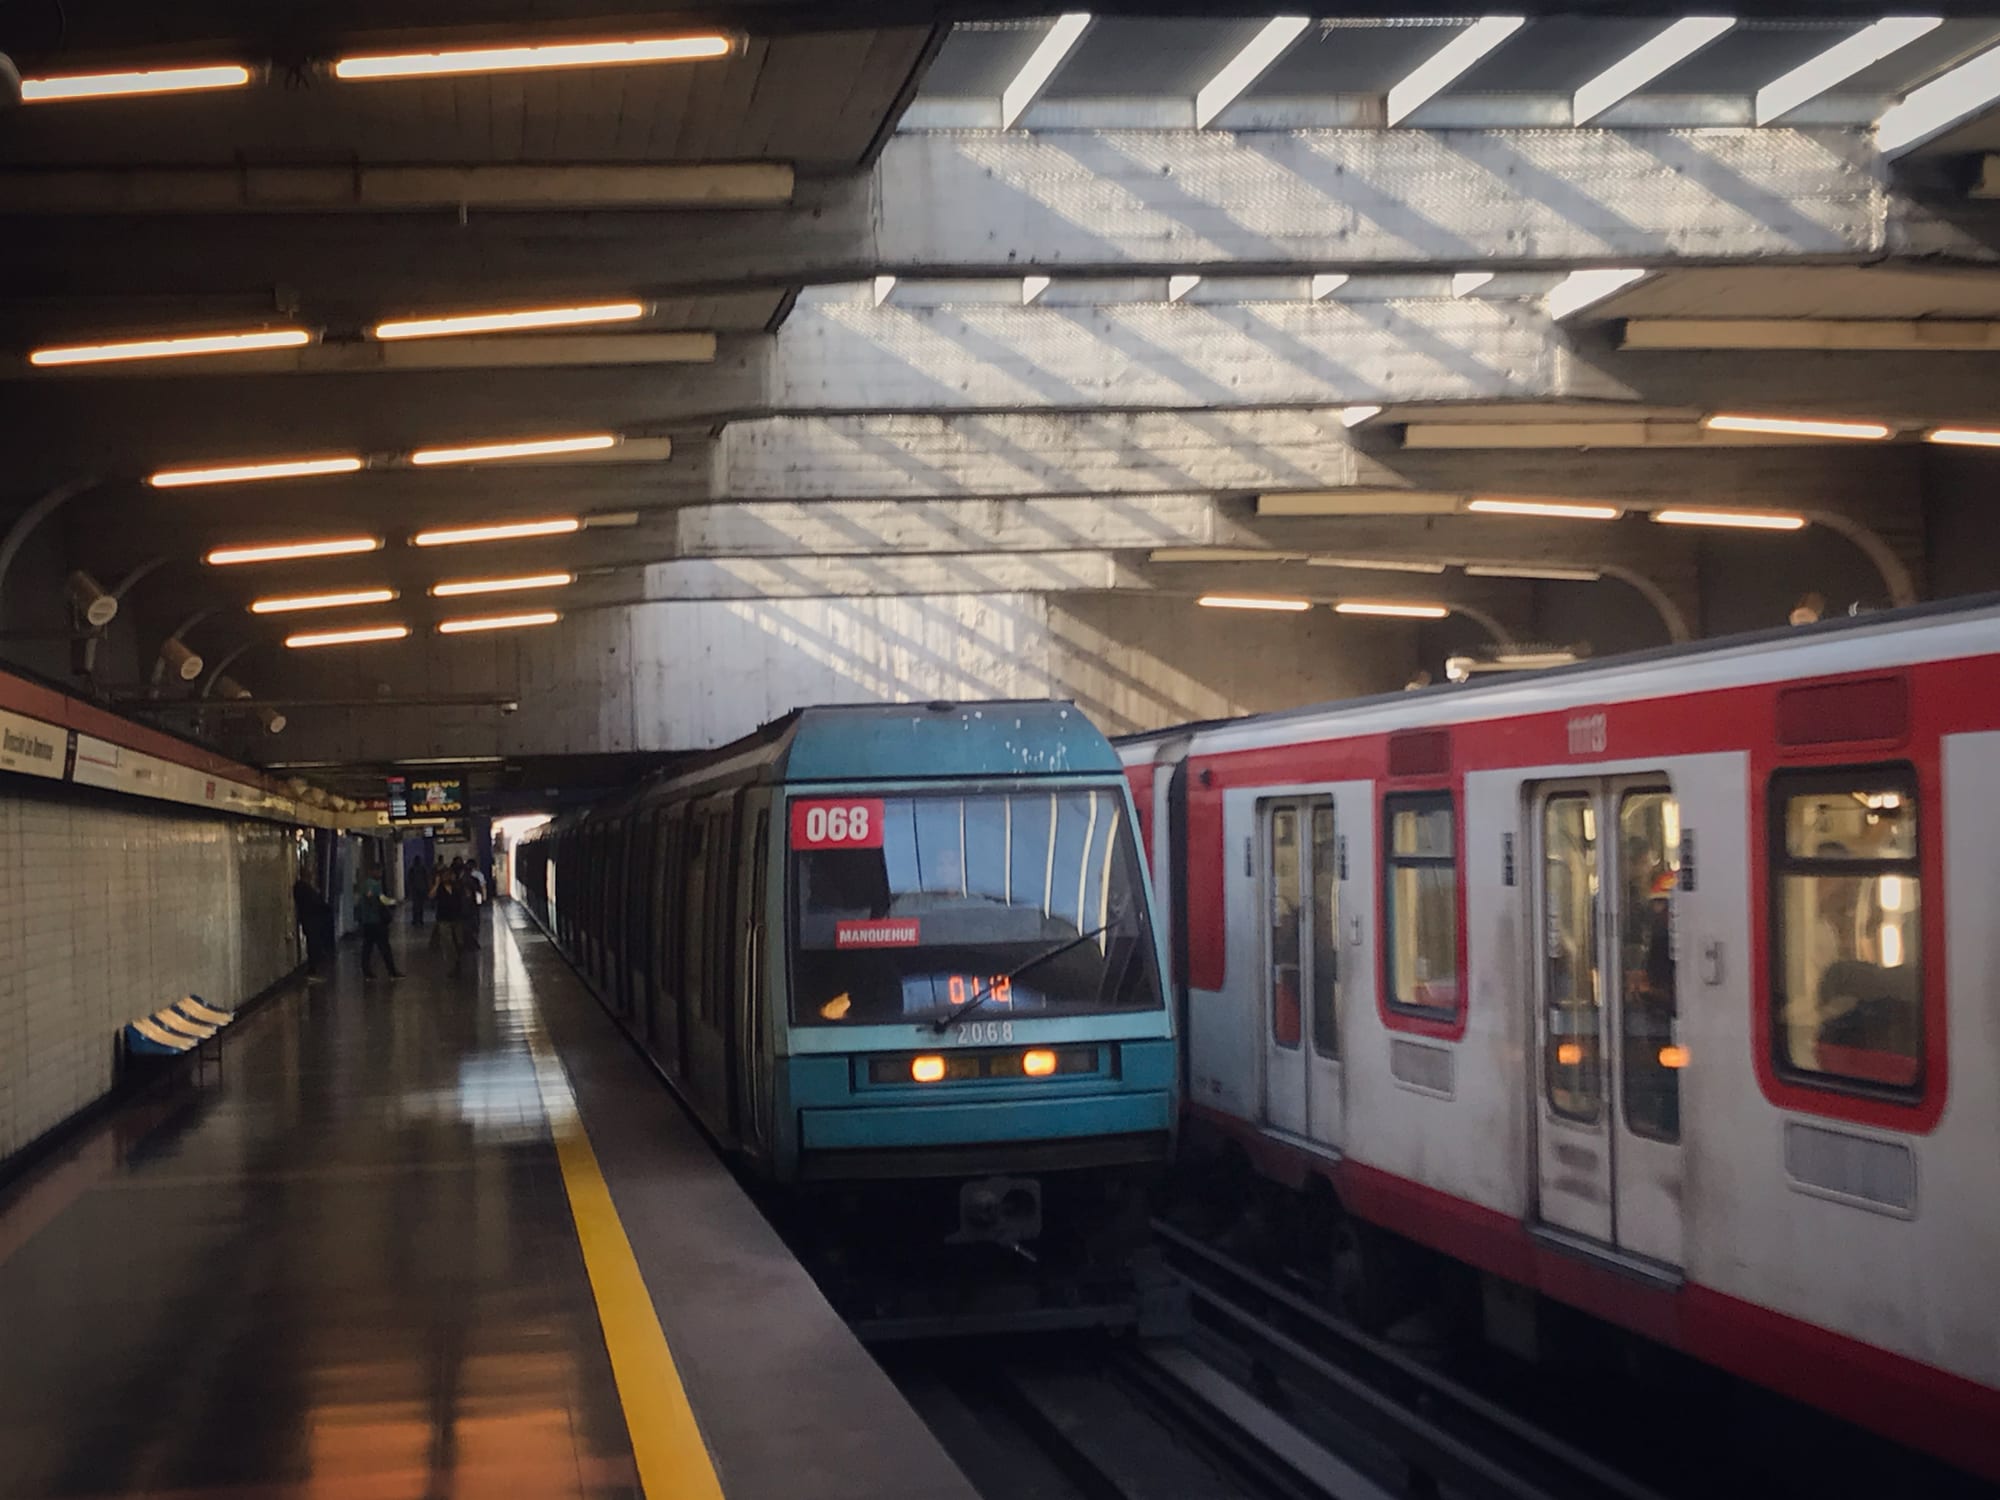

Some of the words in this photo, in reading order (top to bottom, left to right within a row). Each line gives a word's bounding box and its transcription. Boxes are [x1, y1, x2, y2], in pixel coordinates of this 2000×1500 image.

[806, 806, 869, 842] 068
[840, 928, 916, 943] MANQUEHUE
[957, 1019, 1013, 1044] 2068
